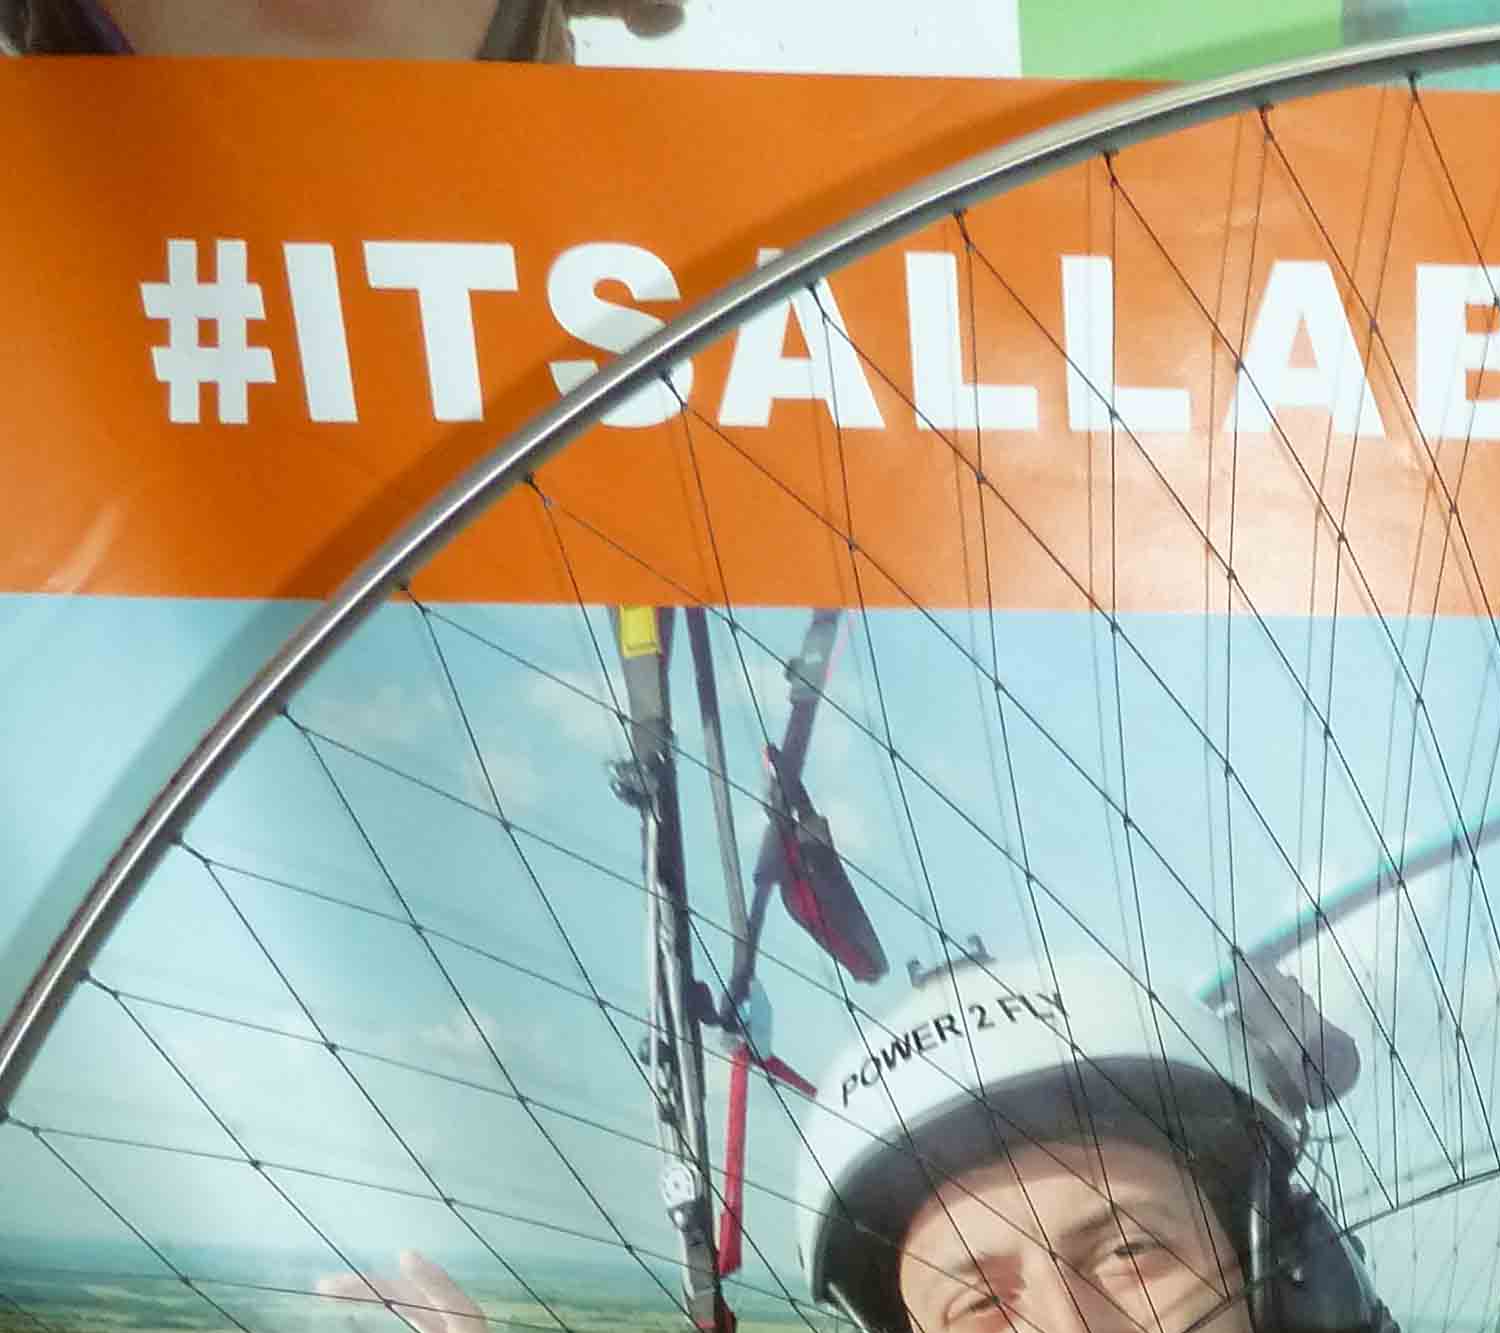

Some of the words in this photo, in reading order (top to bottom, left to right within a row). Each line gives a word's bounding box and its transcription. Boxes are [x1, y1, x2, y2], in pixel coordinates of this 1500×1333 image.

[840, 1012, 964, 1108] POWER
[968, 1003, 996, 1031] 2
[996, 992, 1071, 1025] FLY
